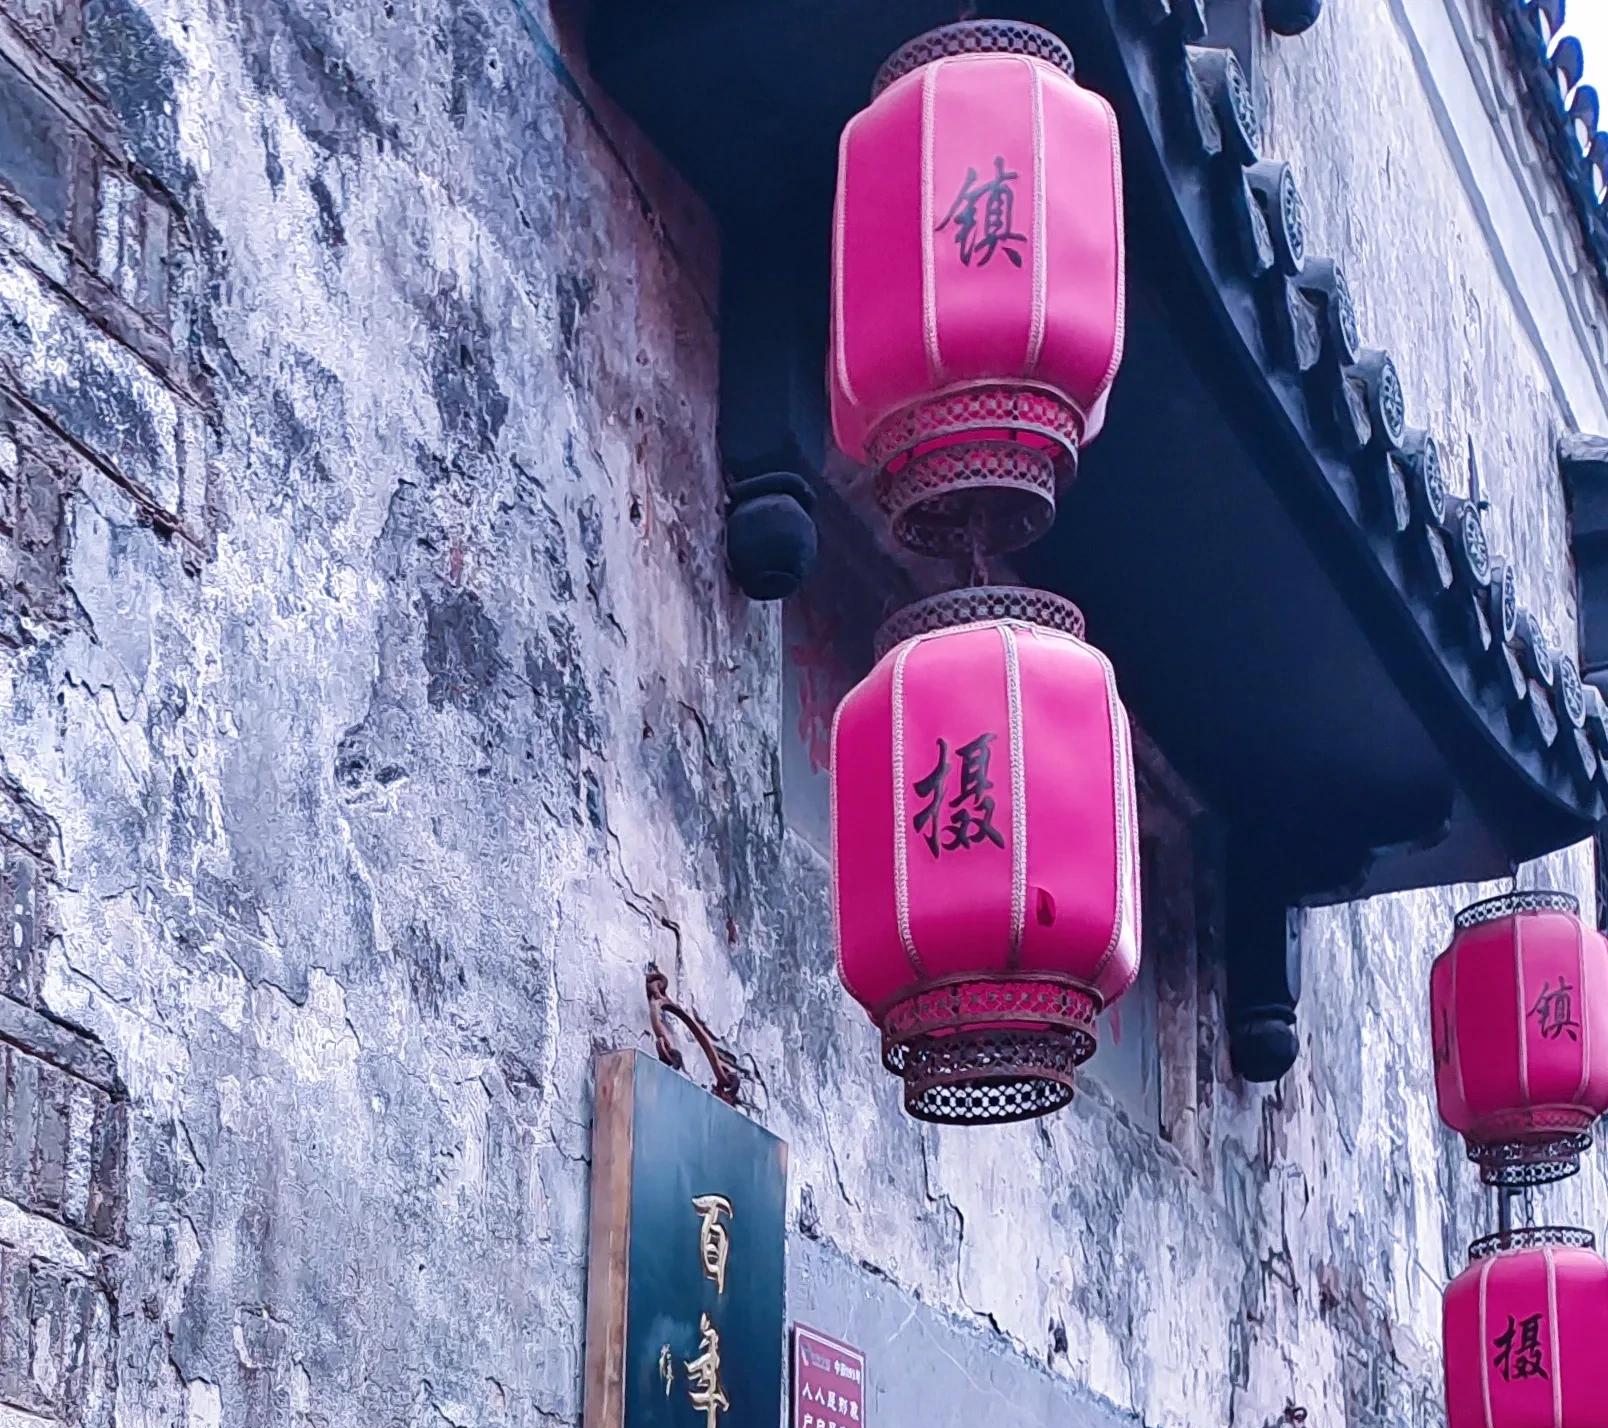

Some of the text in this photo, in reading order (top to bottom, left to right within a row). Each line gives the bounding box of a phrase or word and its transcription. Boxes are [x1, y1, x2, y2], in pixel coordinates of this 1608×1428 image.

[935, 156, 1028, 269] 镇
[913, 732, 1006, 859] 摄
[1527, 976, 1581, 1042] 镇
[1493, 1313, 1549, 1383] 摄
